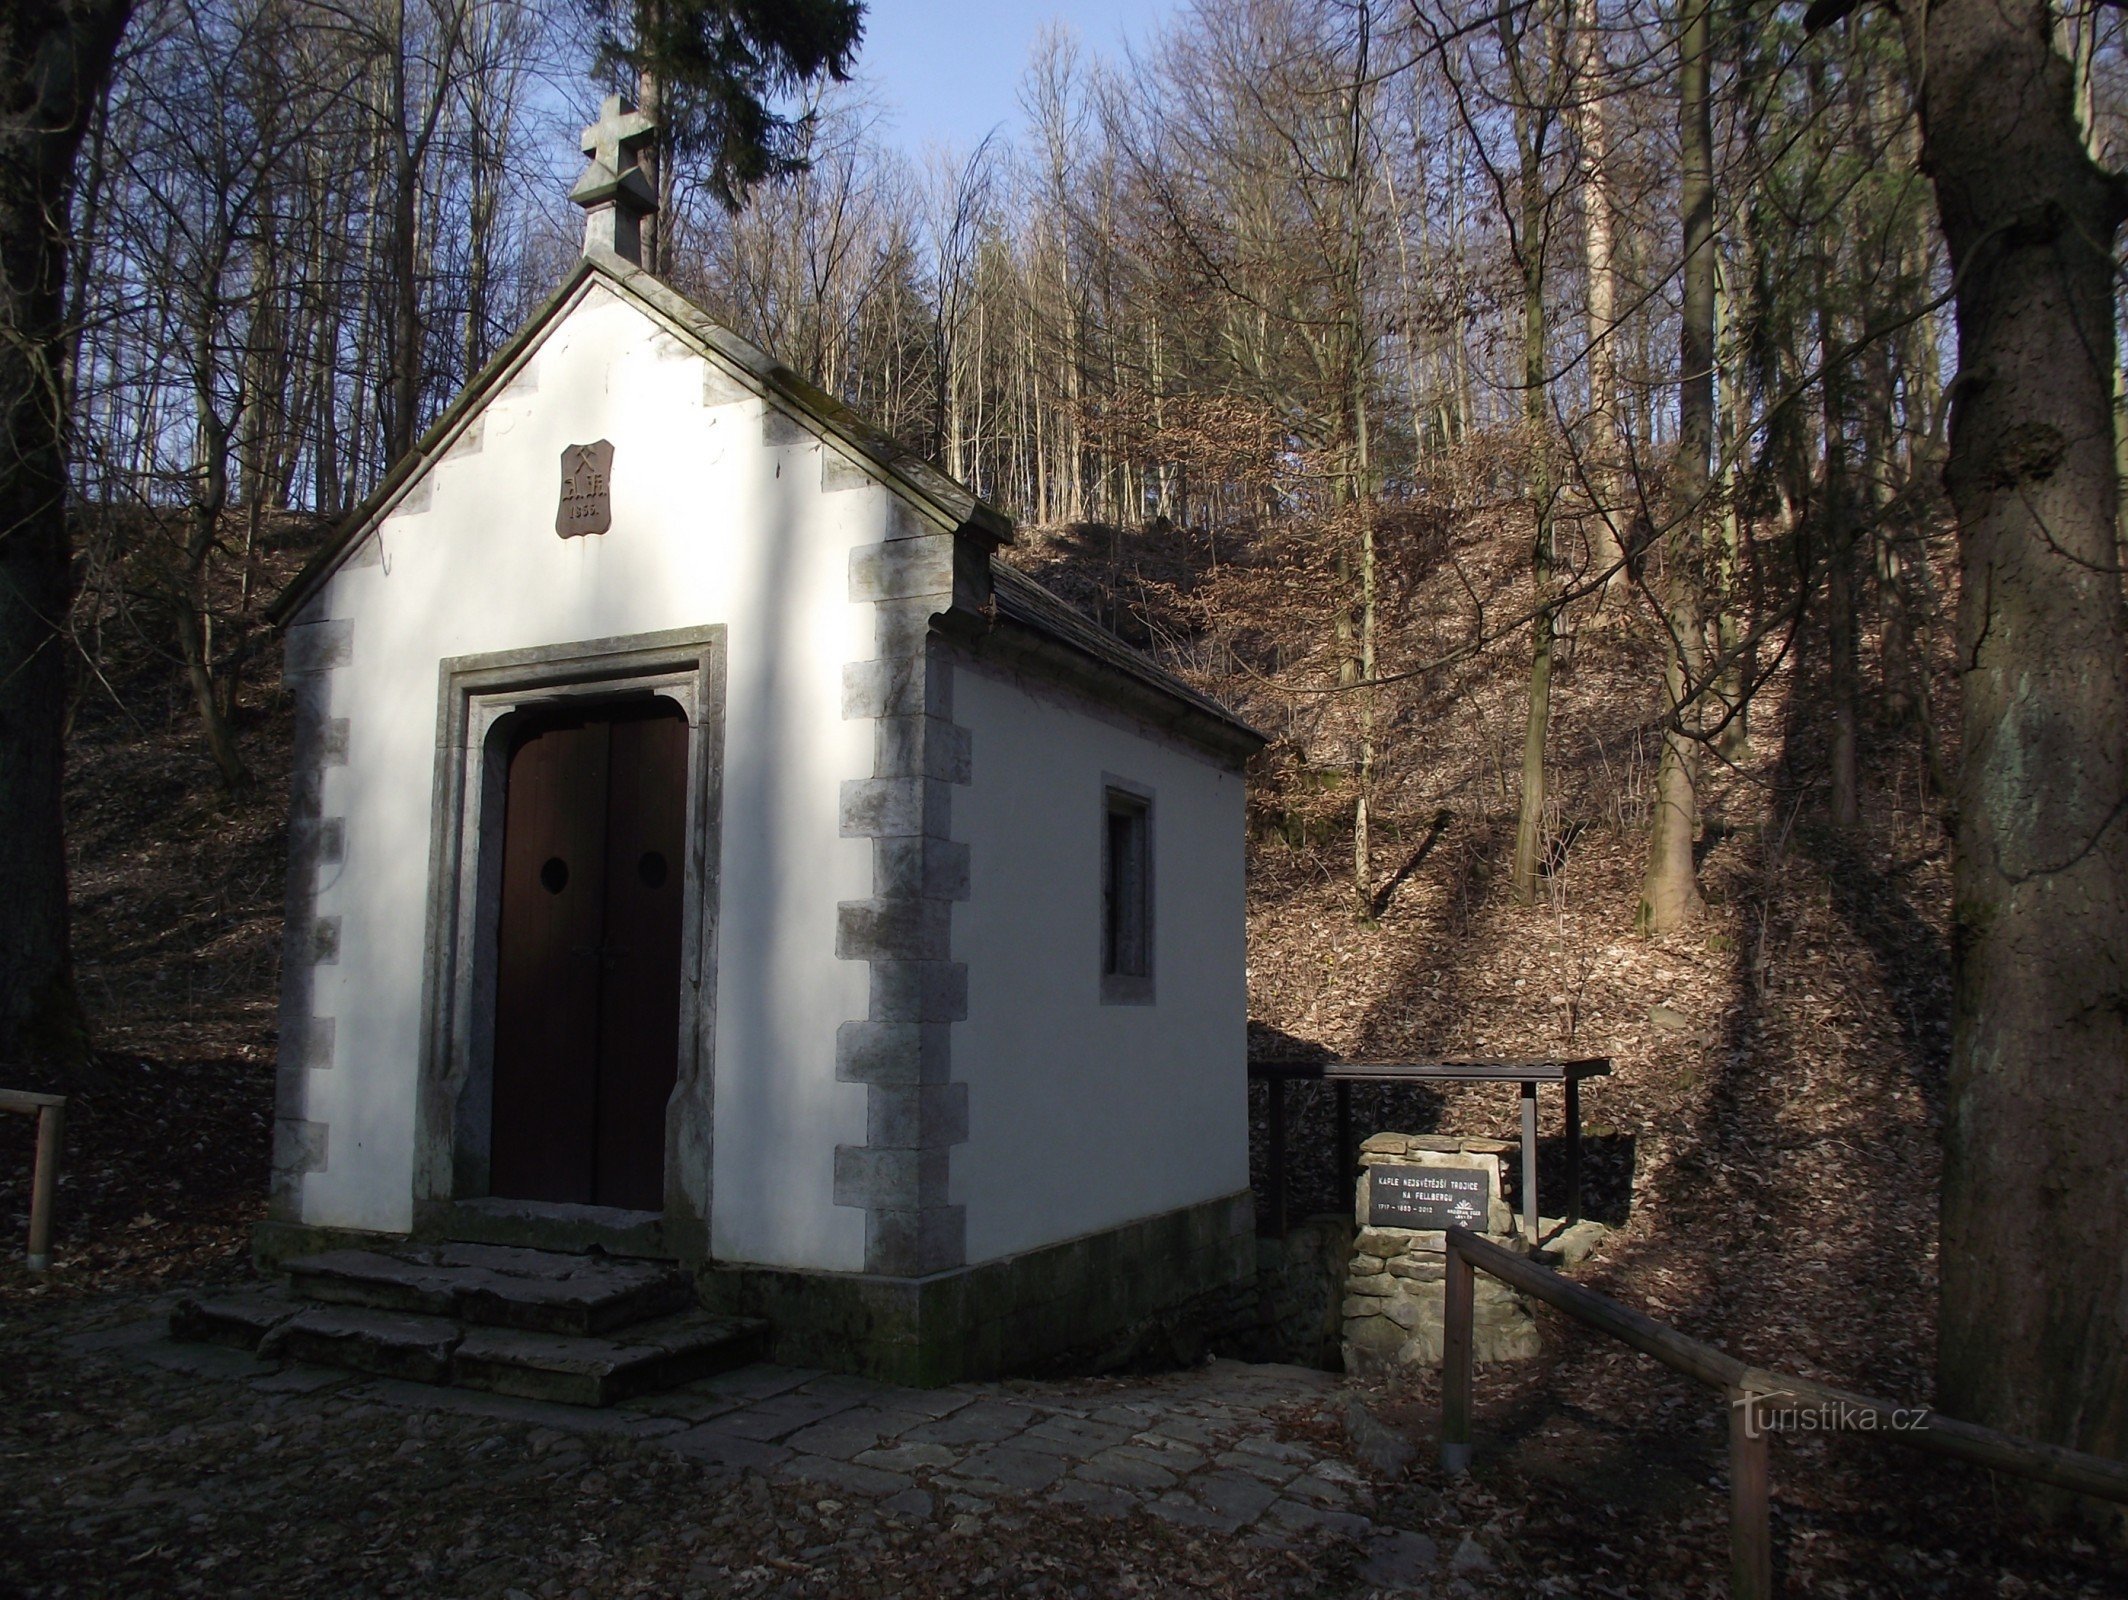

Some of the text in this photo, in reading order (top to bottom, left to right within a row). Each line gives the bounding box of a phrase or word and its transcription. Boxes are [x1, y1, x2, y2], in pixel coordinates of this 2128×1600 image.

[1378, 1178, 1399, 1186] KAPLE
[1451, 1181, 1478, 1190] TROJICE
[1402, 1191, 1452, 1201] NA FELLBERGU
